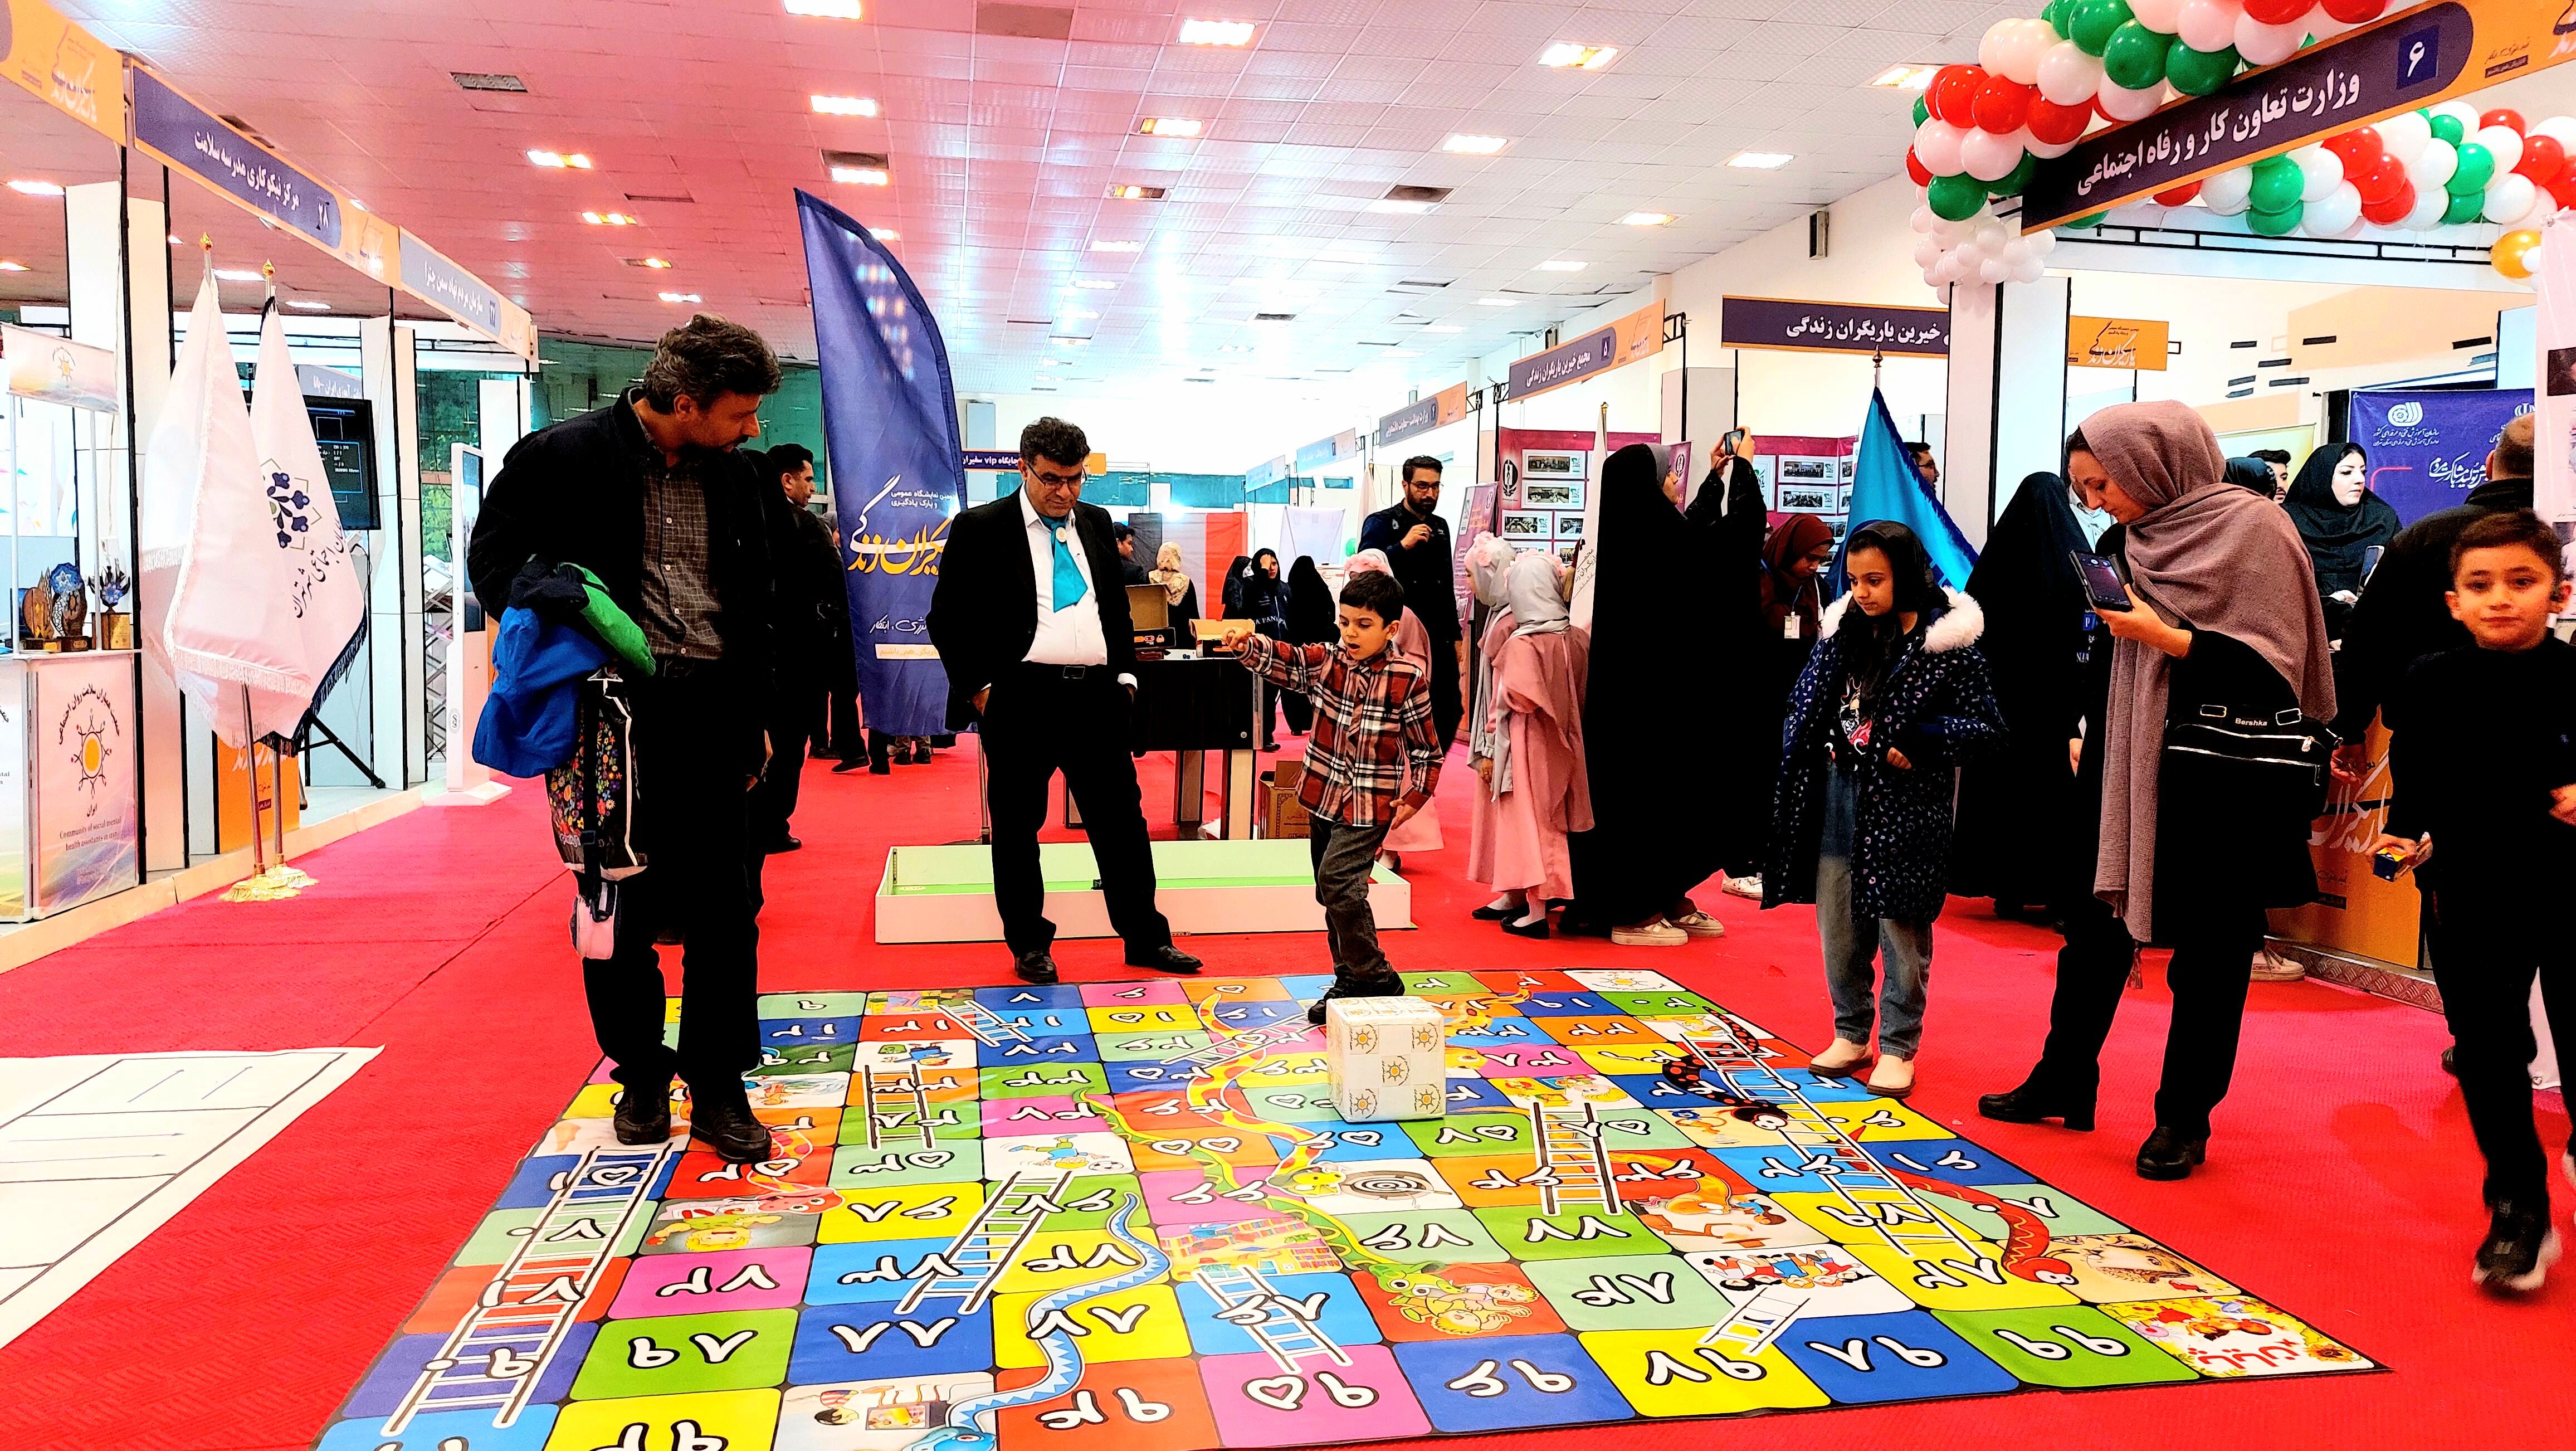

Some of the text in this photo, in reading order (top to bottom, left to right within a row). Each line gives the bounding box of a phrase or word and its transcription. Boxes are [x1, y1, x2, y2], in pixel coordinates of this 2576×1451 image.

[2406, 41, 2426, 78] ۶
[2077, 69, 2361, 197] وزارت تعاون کار و رفاه اجتماعی
[194, 132, 220, 160] سلامت
[221, 148, 246, 177] مدرسه
[283, 183, 300, 211] مرکز
[318, 203, 329, 227] ۲۸
[1785, 315, 1833, 341] زندگی
[1836, 318, 1895, 343] یاریگران
[1897, 322, 1941, 345] خیرین
[1525, 351, 1591, 388] مجمع خیرین یاریگران زندگی
[998, 456, 1018, 467] جایگاه
[891, 498, 938, 509] و پارک یادگیری
[914, 489, 939, 499] نمایشگاه
[870, 613, 890, 634] ابتکار
[82, 683, 96, 697] سلامت
[58, 703, 71, 745] اجتماعی
[2235, 717, 2267, 727] Bershka
[60, 826, 86, 839] Community
[87, 822, 92, 831] of
[93, 820, 106, 830] social
[66, 840, 80, 851] health
[81, 835, 103, 847] assistants
